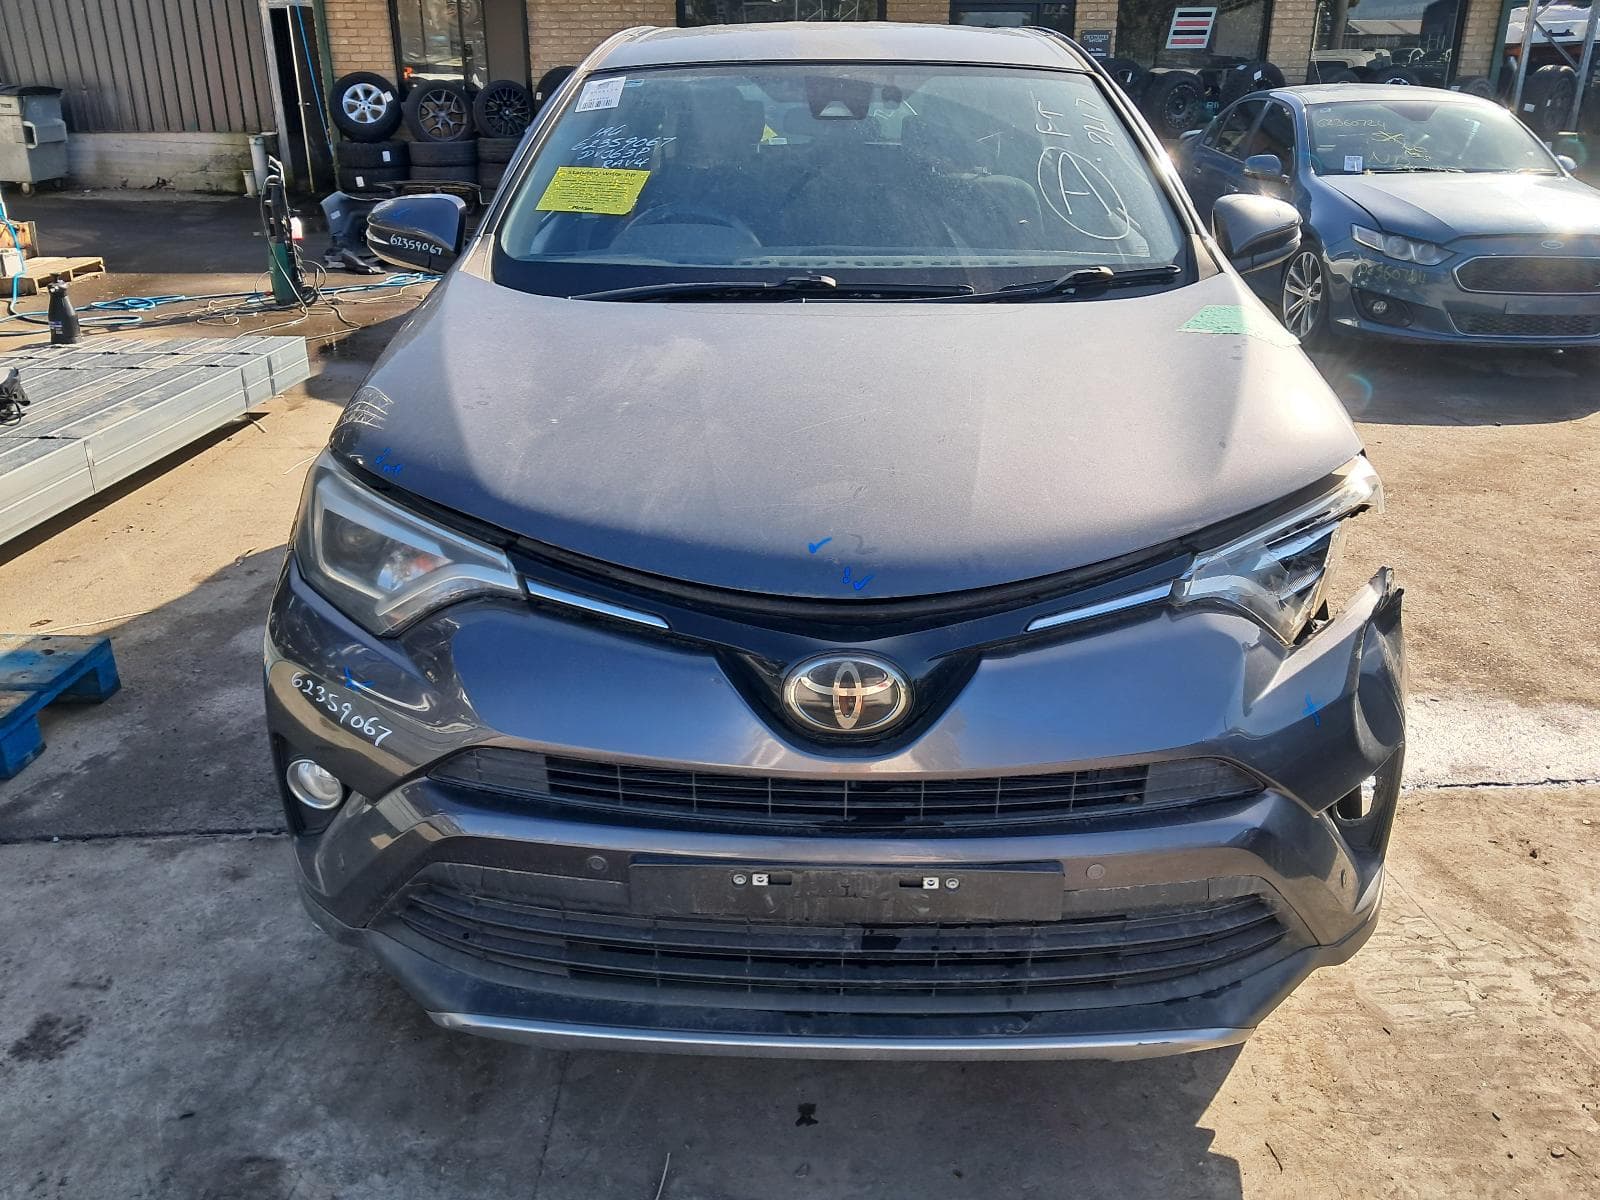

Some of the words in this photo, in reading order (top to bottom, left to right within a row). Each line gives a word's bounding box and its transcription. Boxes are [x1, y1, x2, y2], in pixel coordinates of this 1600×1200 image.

[571, 136, 678, 151] 62359067
[602, 158, 650, 169] RAV4
[390, 233, 443, 256] 62359067
[291, 672, 393, 747] 62359067
